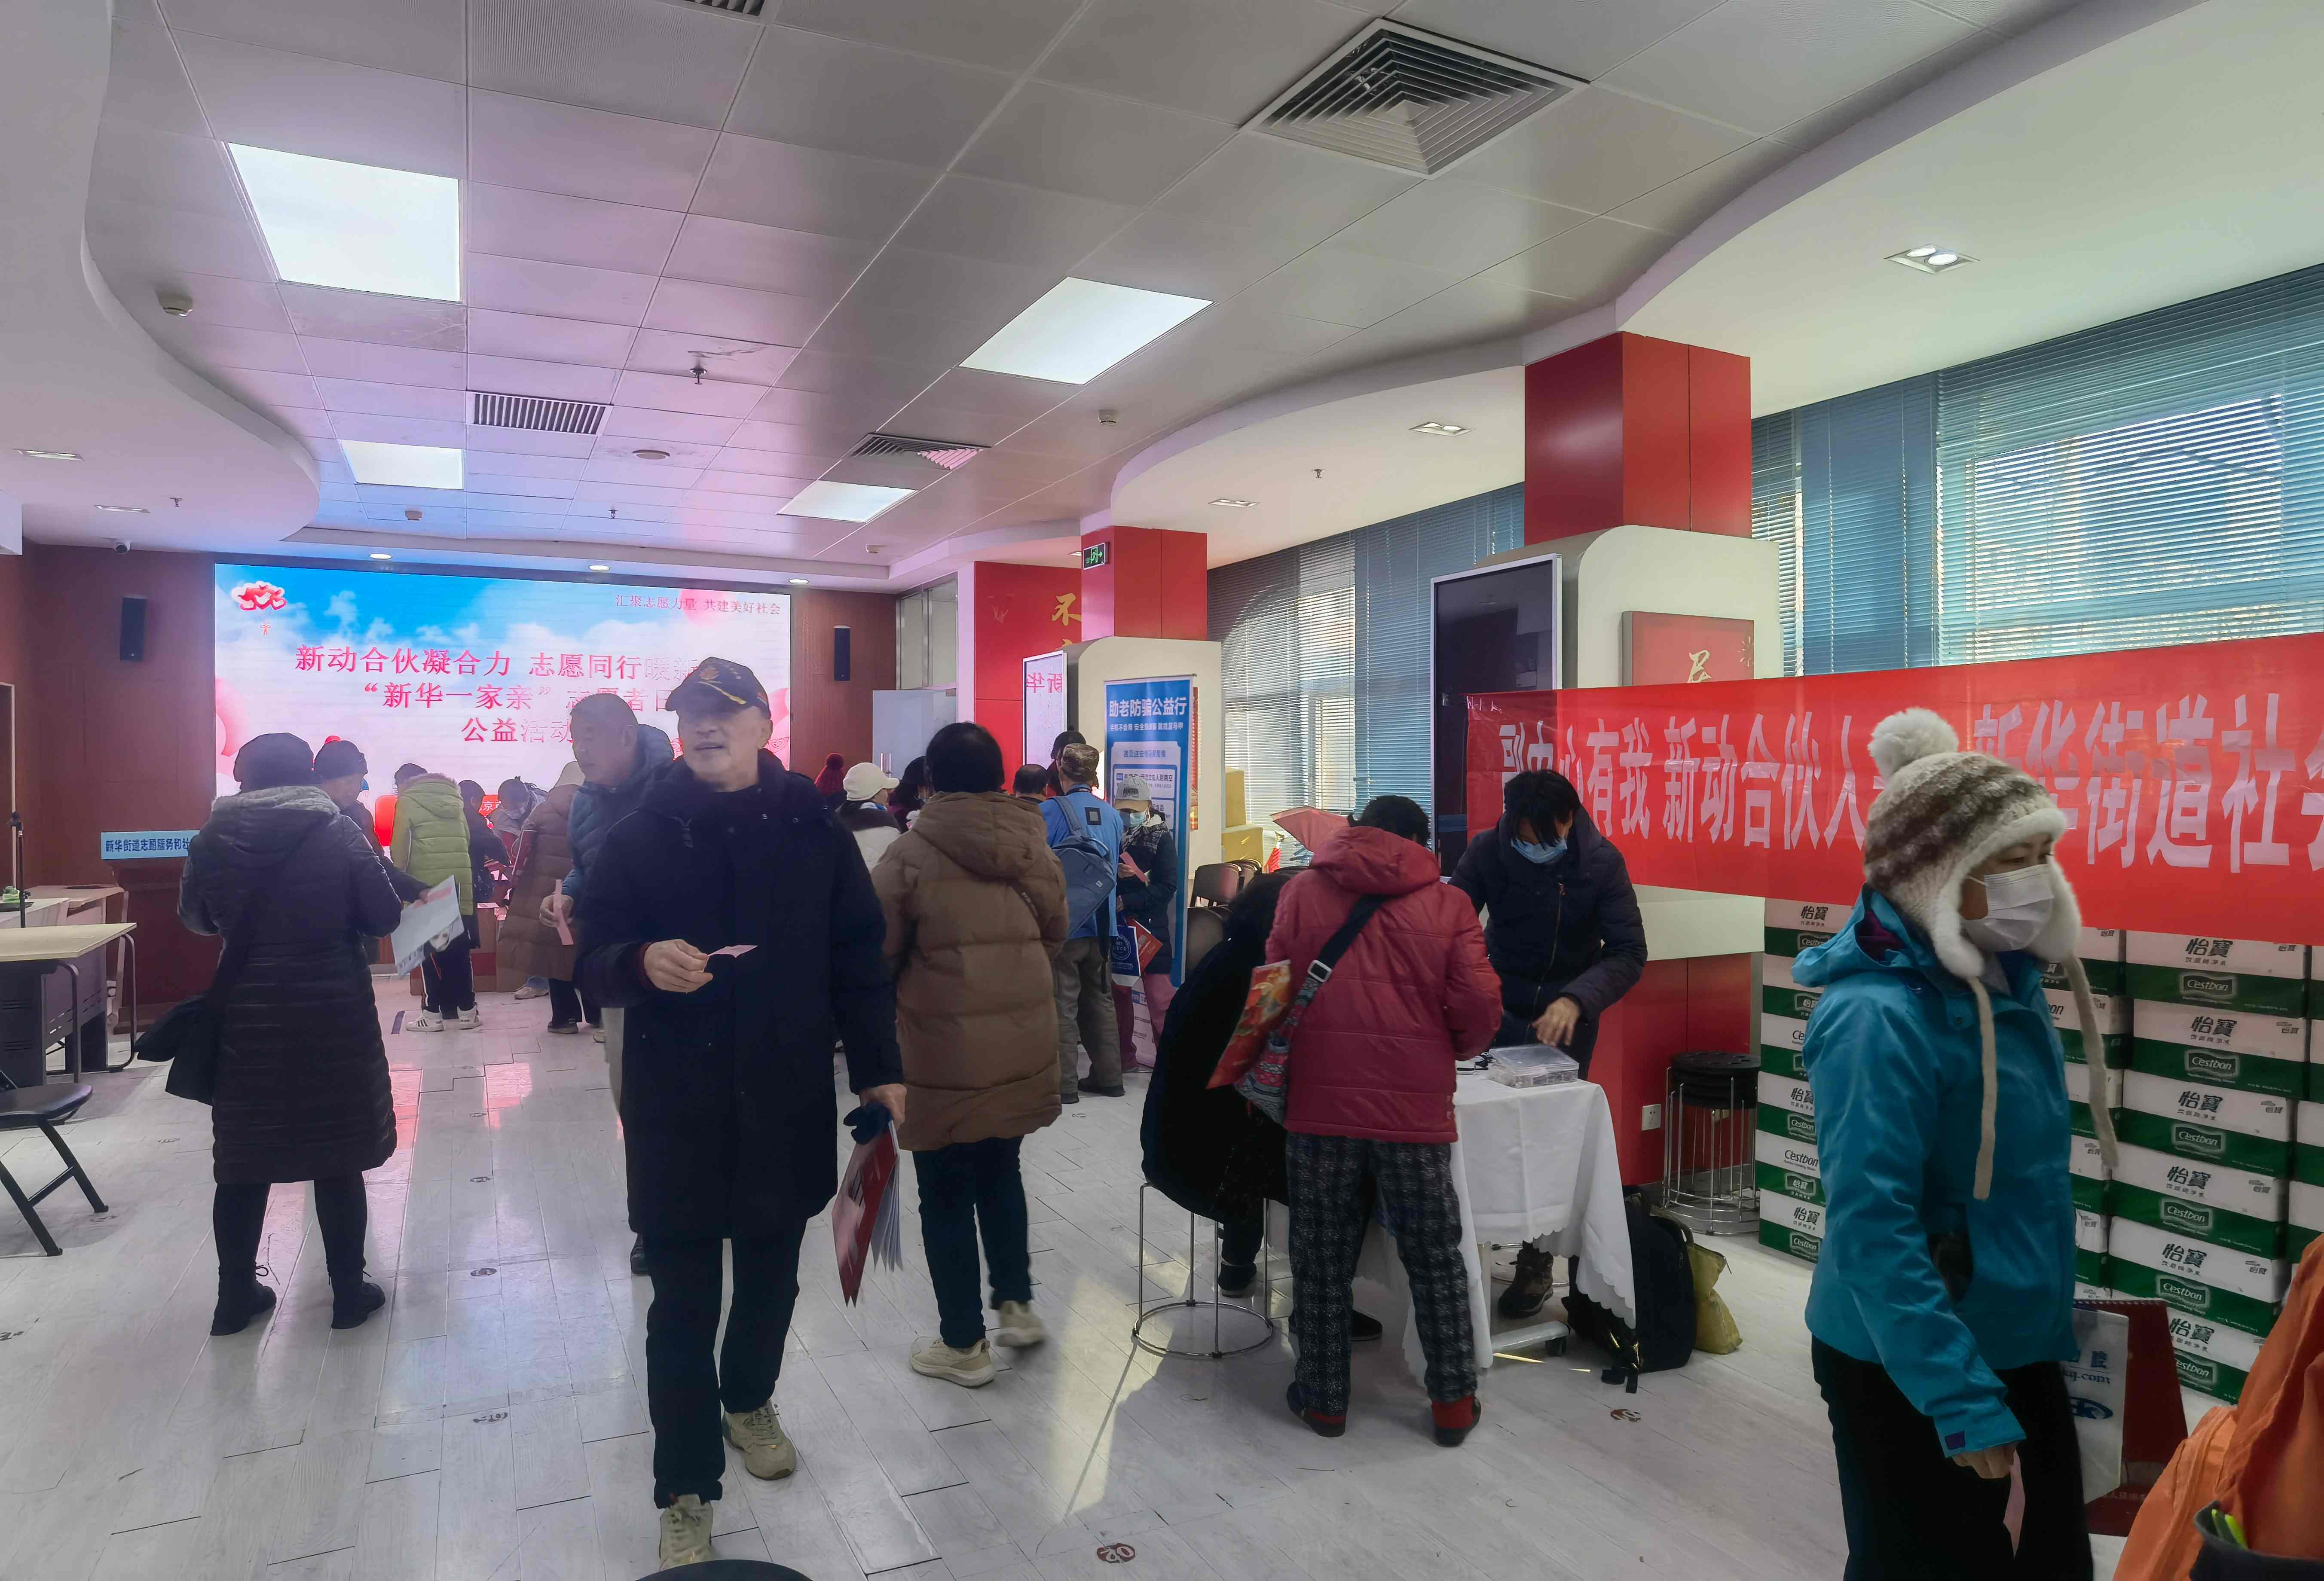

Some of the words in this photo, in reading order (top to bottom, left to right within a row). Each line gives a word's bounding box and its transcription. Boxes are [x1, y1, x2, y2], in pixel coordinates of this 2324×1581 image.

[615, 595, 697, 610] 汇聚志愿力量
[704, 598, 781, 615] 共建美好社会
[295, 644, 511, 676] 新动合伙凝合力
[1109, 697, 1187, 717] 助老防骗公益行
[1663, 711, 1884, 850] 新动合伙人
